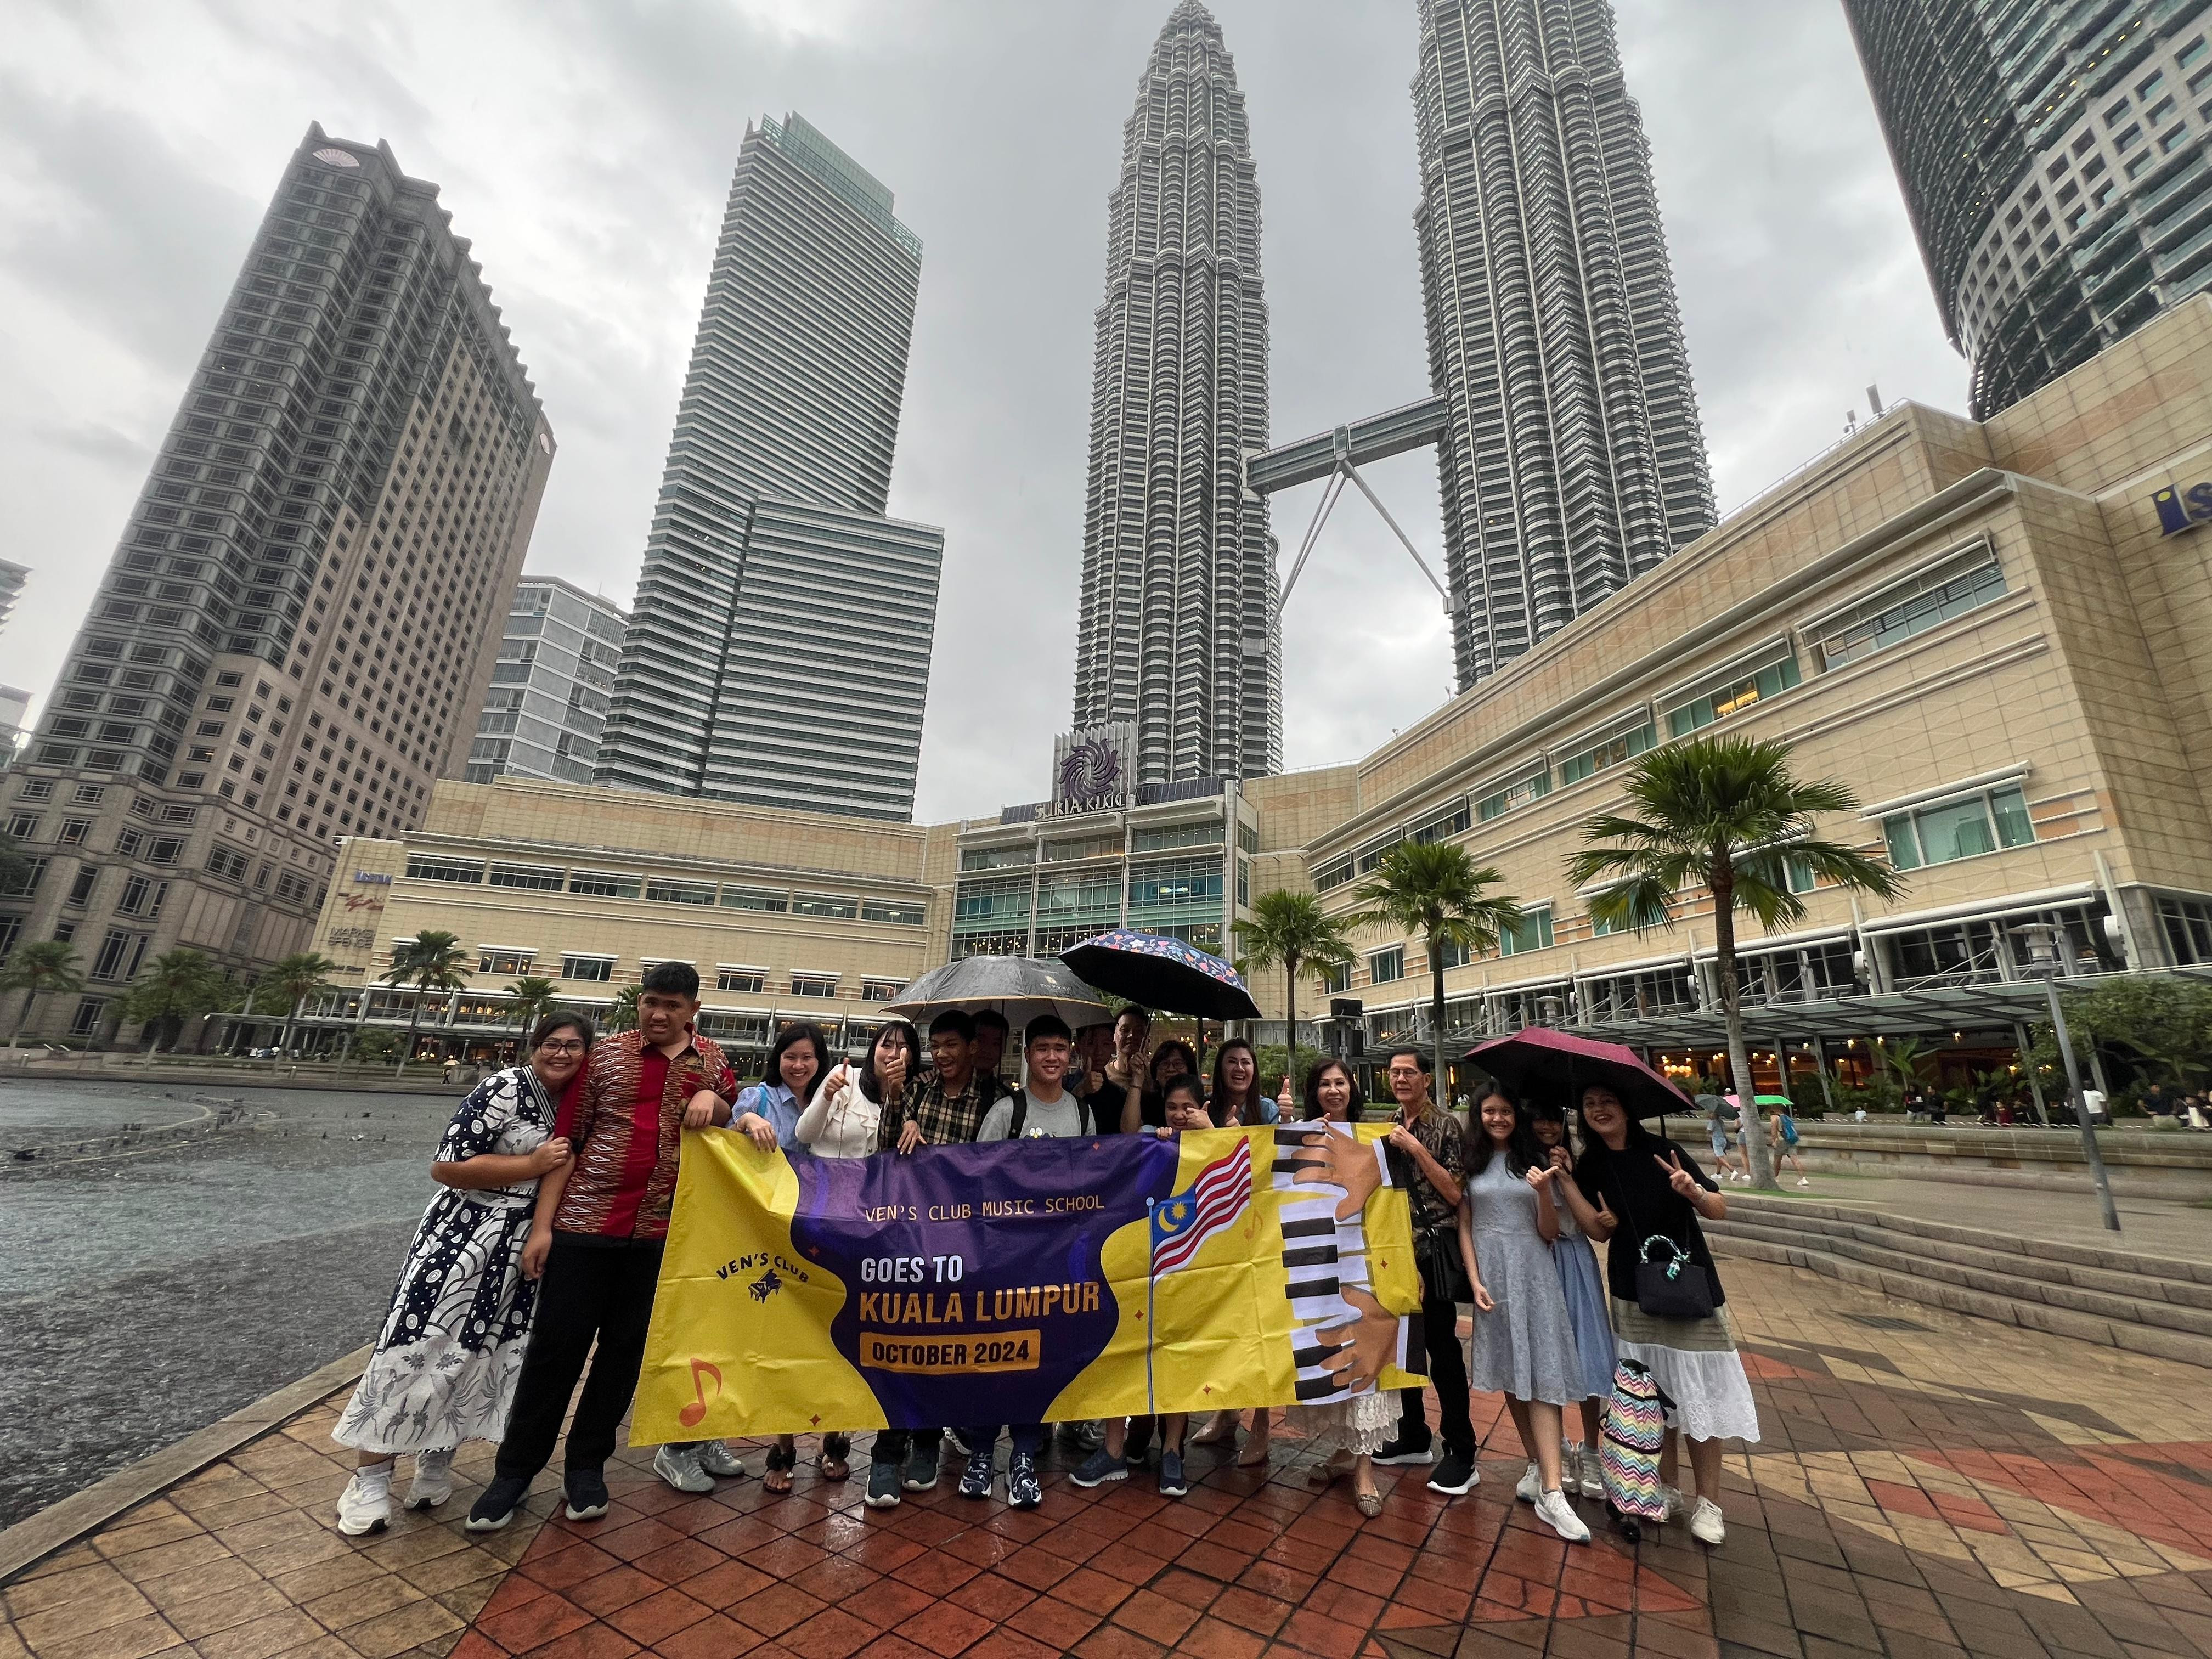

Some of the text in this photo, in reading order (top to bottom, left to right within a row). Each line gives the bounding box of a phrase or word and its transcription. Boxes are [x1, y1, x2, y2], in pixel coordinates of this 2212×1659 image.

[1035, 792, 1125, 820] SURIA KLCC
[866, 1195, 1105, 1222] VEN'S CLUB MUSIC SCHOOL
[716, 1252, 809, 1283] VEN'S CLUB
[861, 1255, 963, 1283] GOES TO
[860, 1281, 1100, 1324] KUALA LUMPUR
[872, 1340, 1029, 1366] OCTOBER 2024
